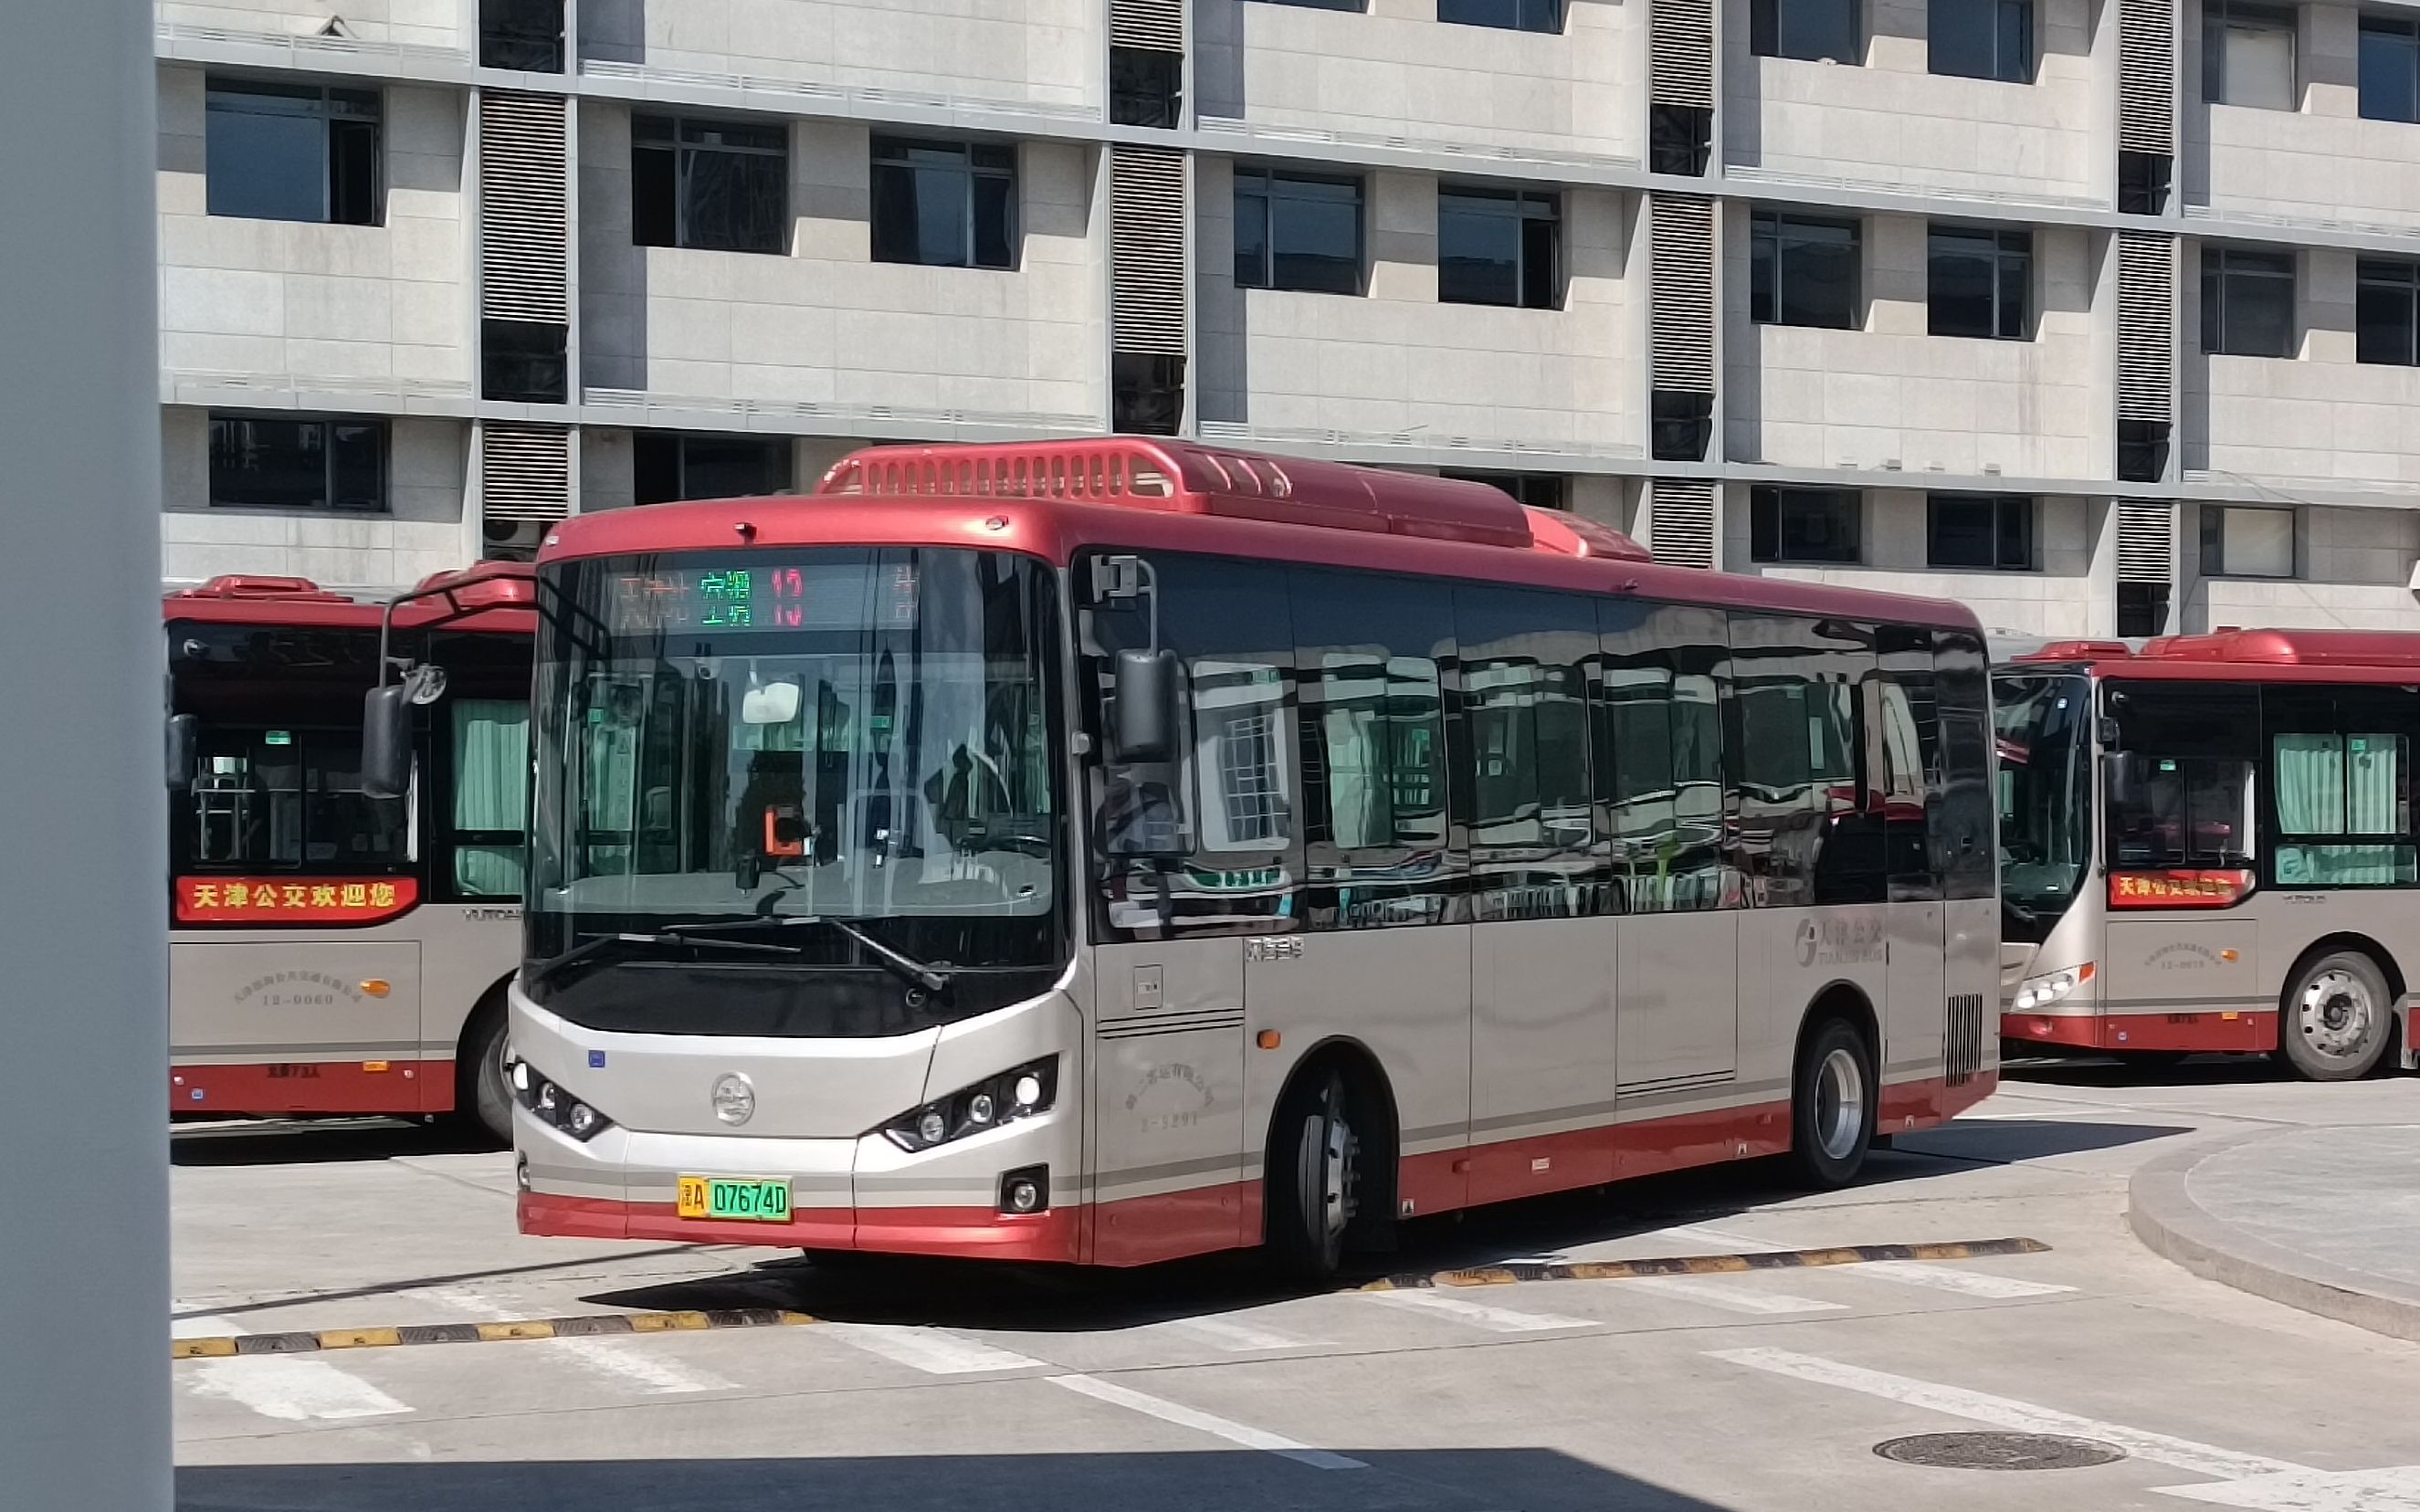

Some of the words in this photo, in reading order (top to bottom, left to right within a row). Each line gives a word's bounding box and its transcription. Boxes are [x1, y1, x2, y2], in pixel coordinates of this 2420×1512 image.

[193, 883, 396, 908] 天津公交欢迎您
